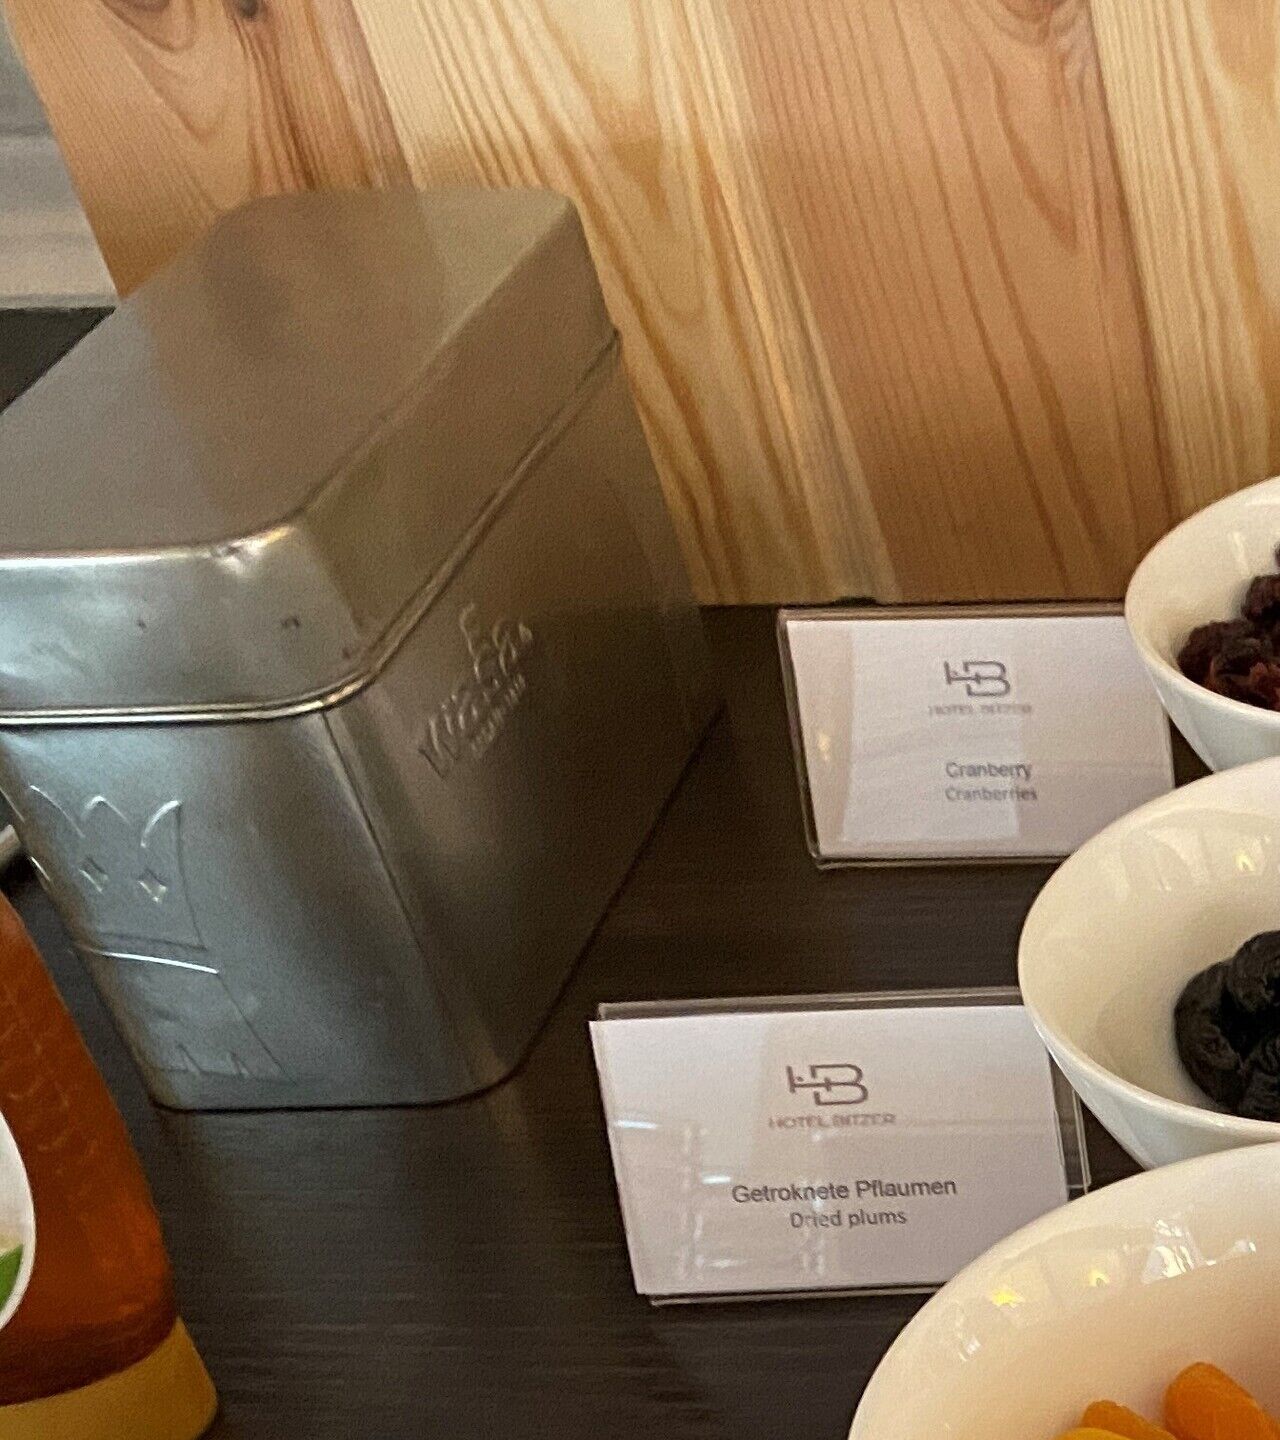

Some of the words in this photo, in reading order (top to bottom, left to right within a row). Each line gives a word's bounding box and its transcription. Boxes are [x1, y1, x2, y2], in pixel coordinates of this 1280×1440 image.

[946, 762, 1033, 781] Cranberry
[945, 786, 1037, 802] Cranberries
[768, 1115, 826, 1130] HOTEL
[831, 1113, 897, 1127] BITZER
[732, 1182, 850, 1204] Getroknete
[855, 1179, 957, 1199] Pflaumen
[790, 1209, 843, 1228] Dried
[849, 1207, 907, 1228] plums
